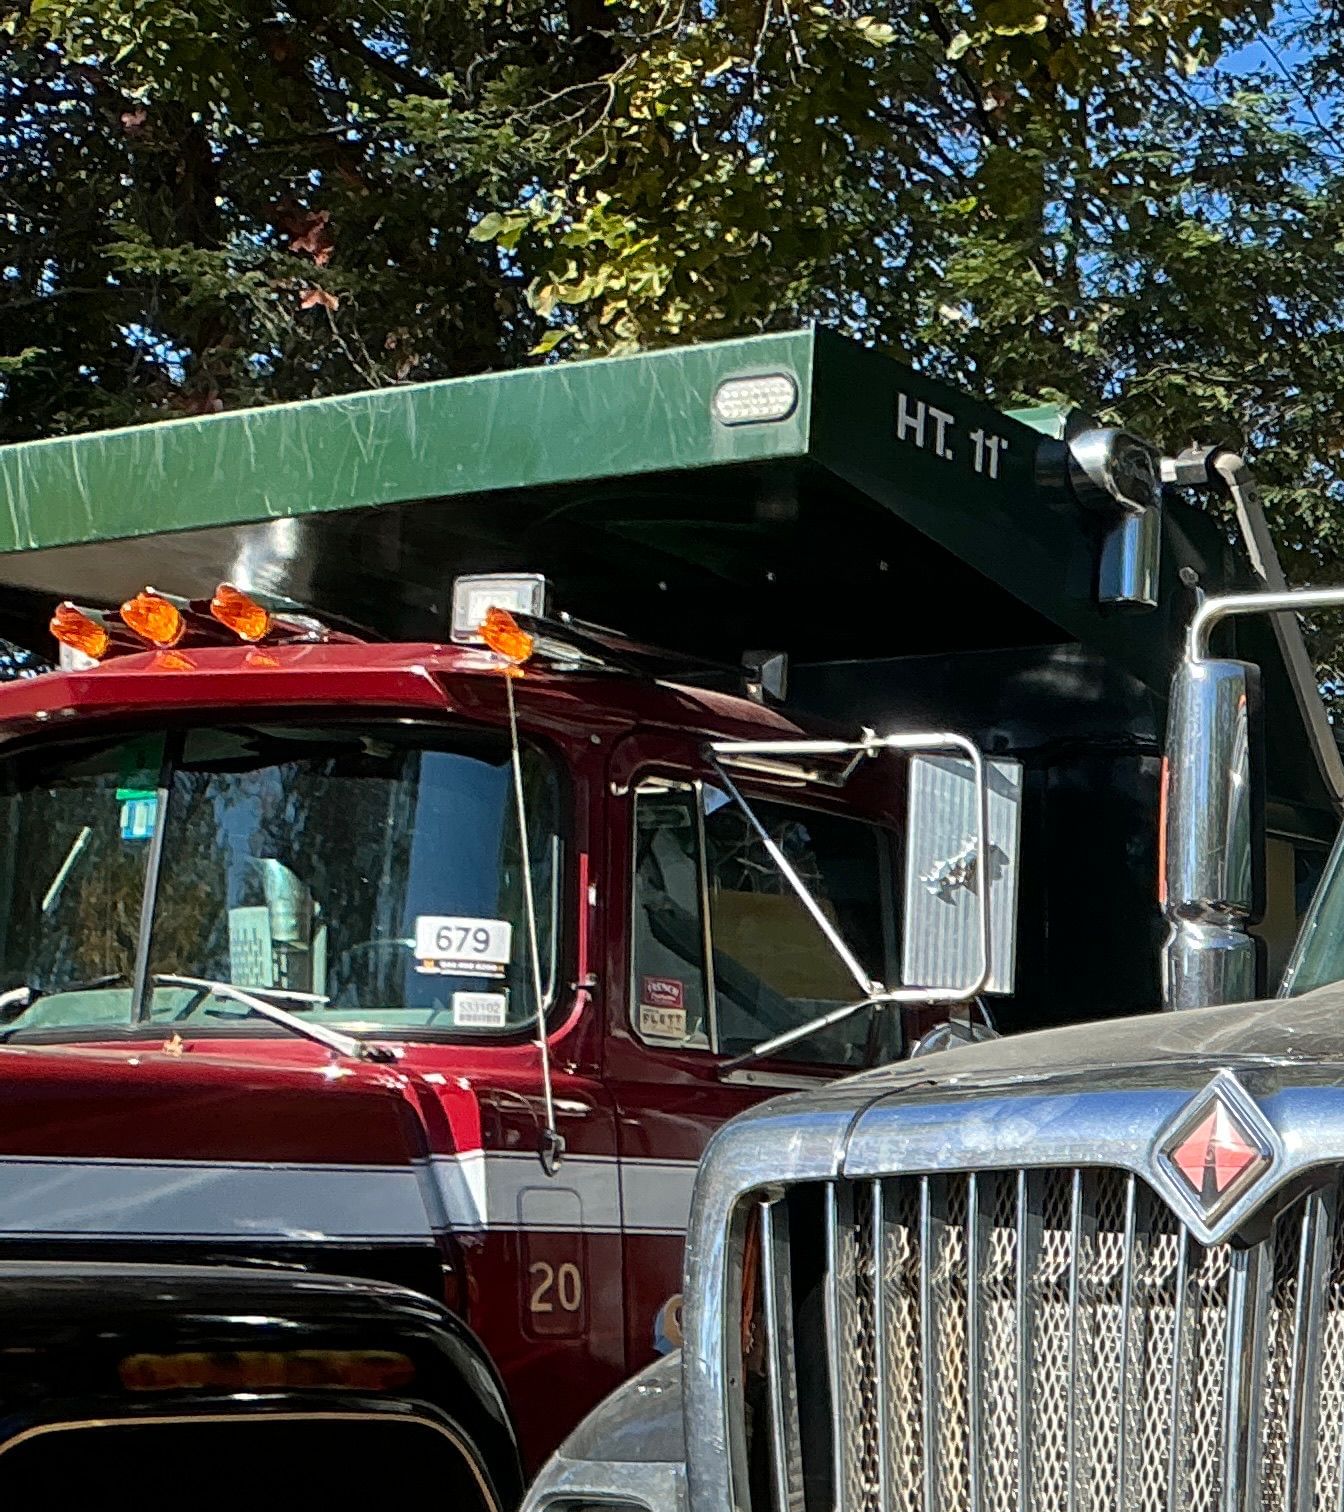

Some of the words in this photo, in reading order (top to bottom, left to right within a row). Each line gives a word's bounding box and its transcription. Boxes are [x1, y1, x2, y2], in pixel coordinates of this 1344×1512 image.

[897, 392, 954, 460] HT.
[436, 926, 491, 953] 679
[528, 1261, 582, 1313] 20
